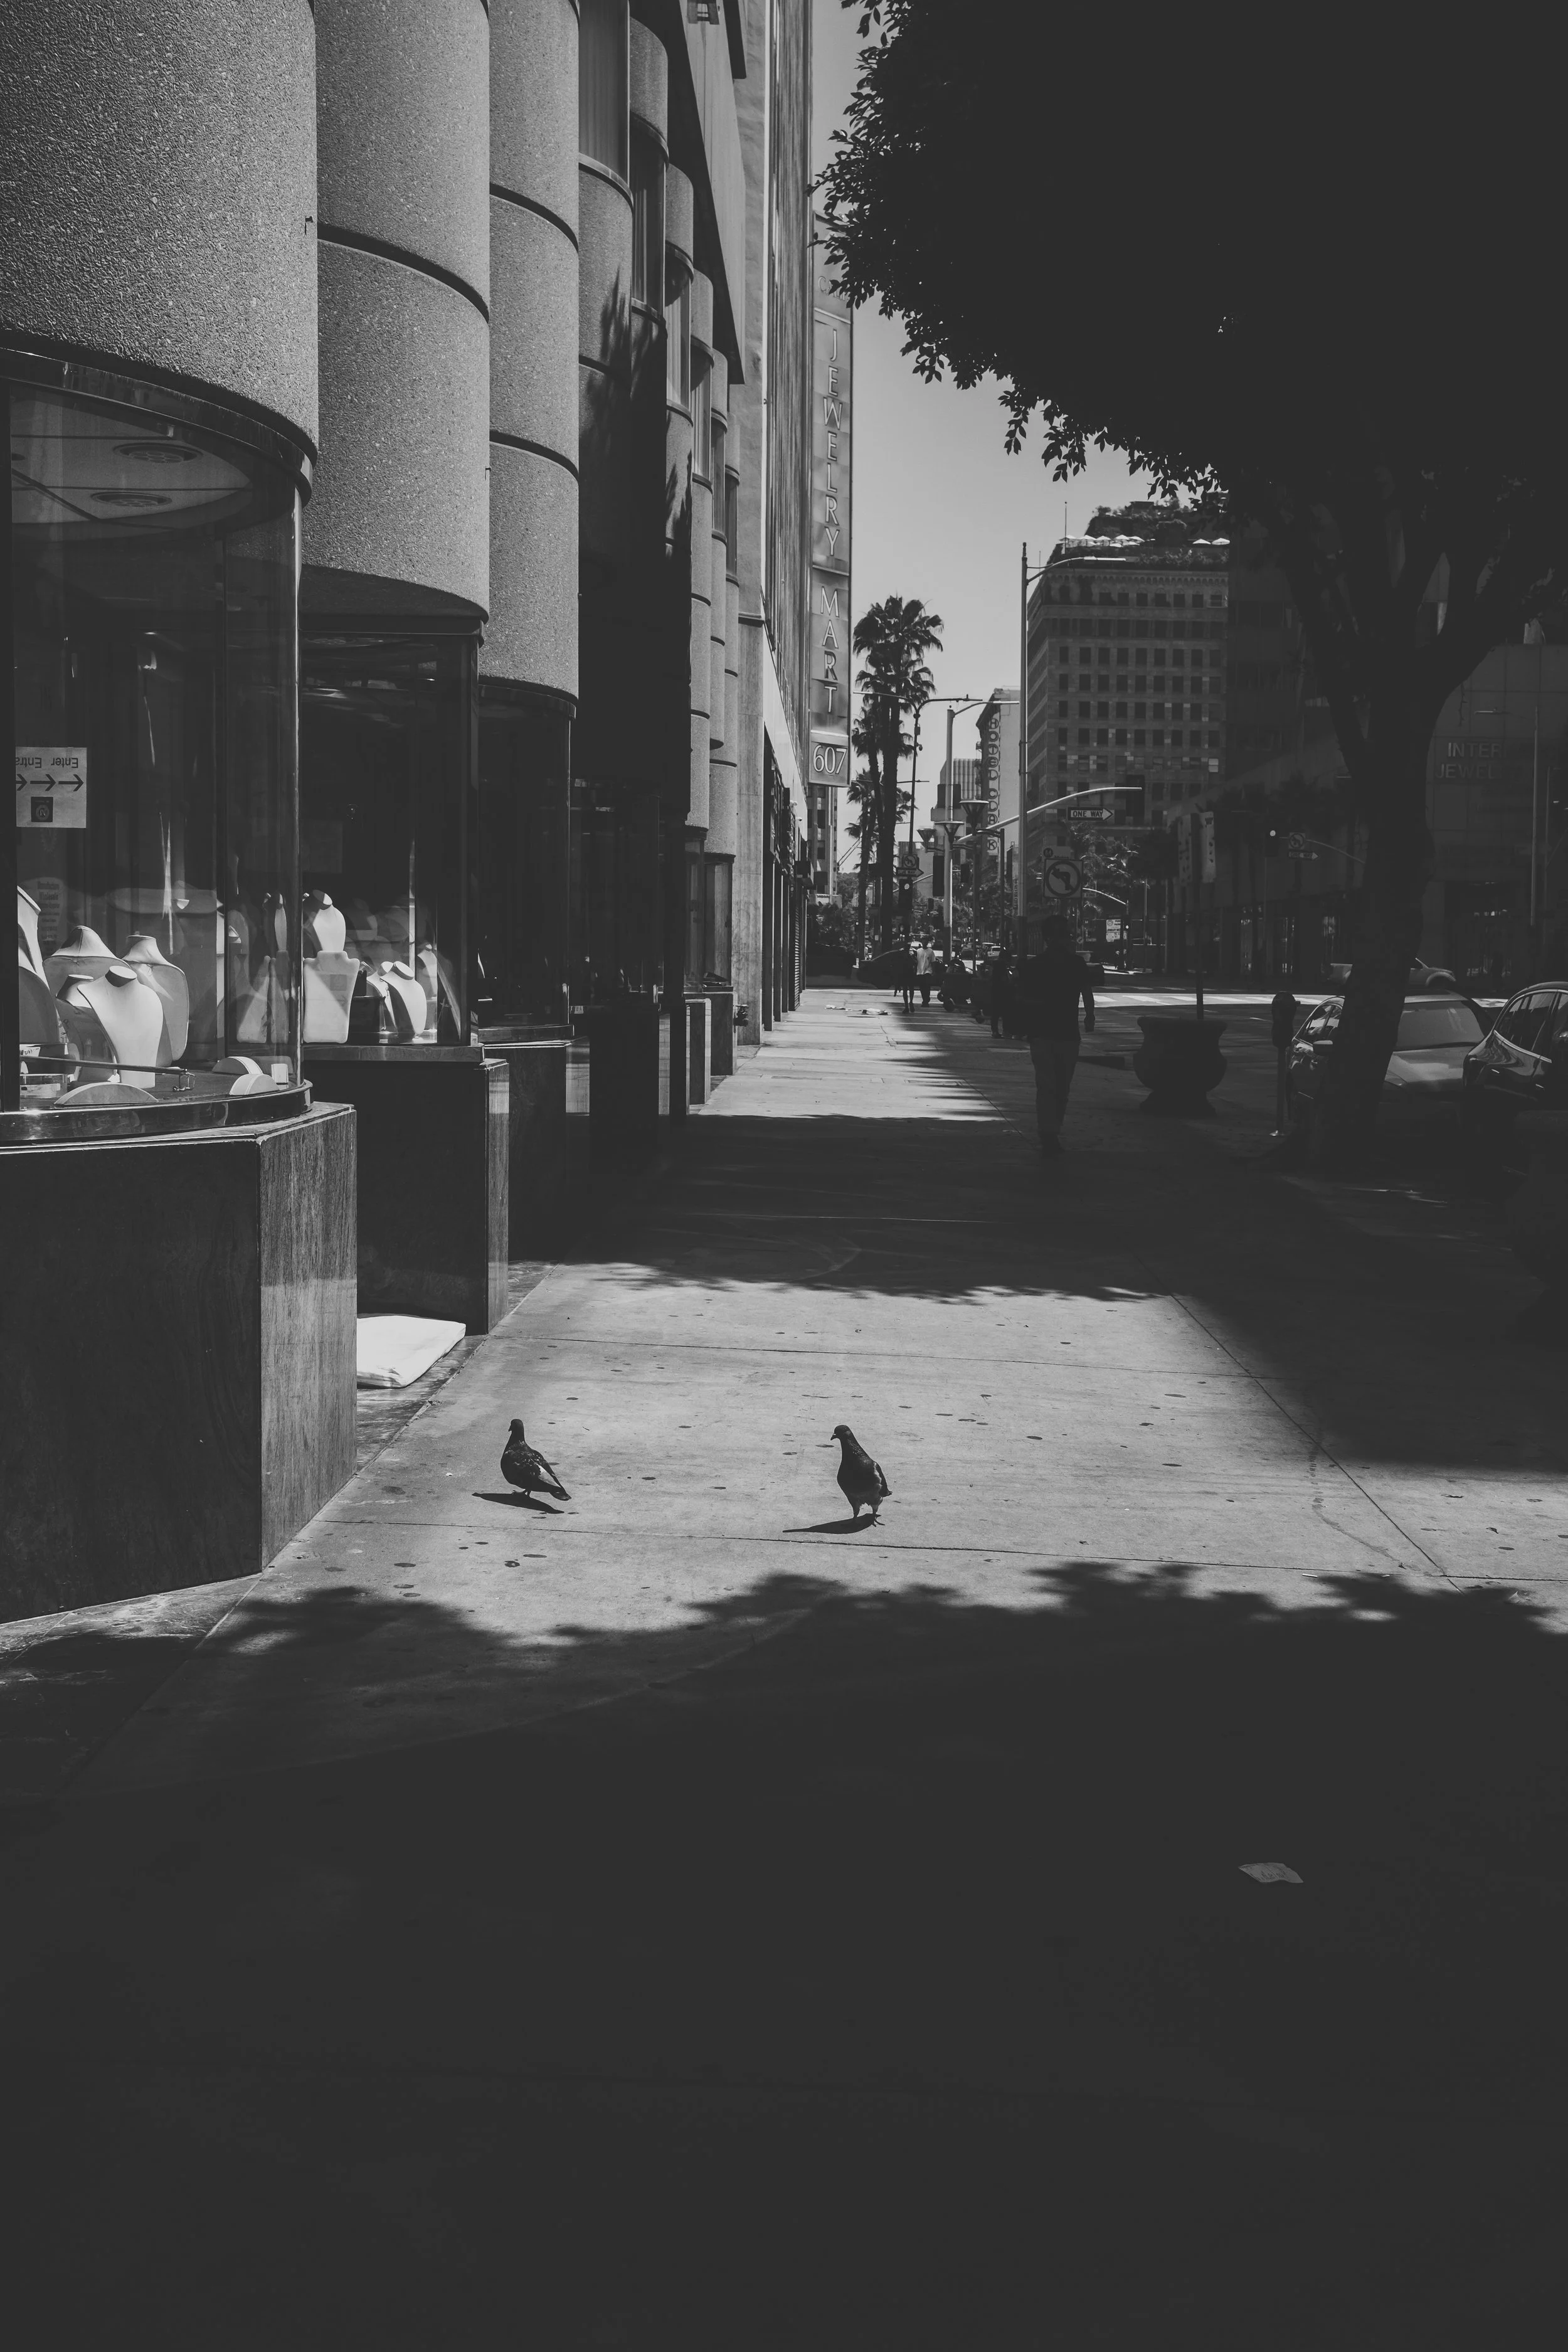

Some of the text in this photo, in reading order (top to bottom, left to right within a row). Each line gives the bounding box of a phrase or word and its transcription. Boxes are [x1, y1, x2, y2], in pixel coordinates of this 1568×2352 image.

[820, 329, 843, 714] JEWELRY MART
[51, 757, 78, 768] Enter
[813, 744, 848, 775] 607
[988, 718, 999, 850] HOTEL CLAK
